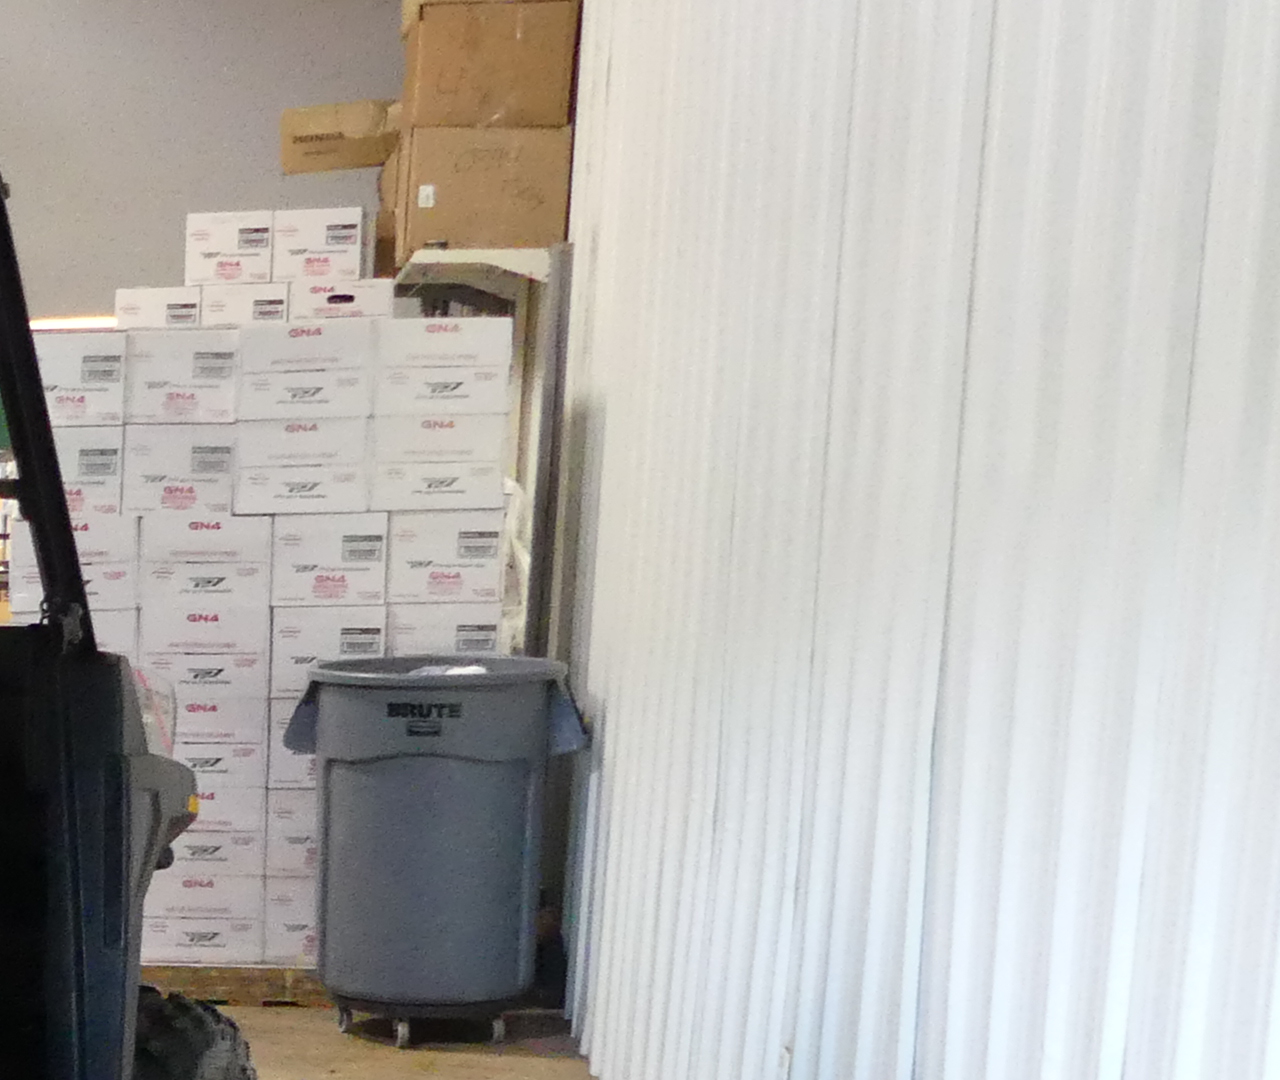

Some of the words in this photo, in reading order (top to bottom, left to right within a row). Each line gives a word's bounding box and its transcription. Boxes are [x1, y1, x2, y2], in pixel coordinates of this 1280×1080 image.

[189, 521, 222, 531] GN4
[187, 613, 220, 623] GN4
[186, 703, 218, 713] GN4
[387, 702, 463, 719] BRUTE
